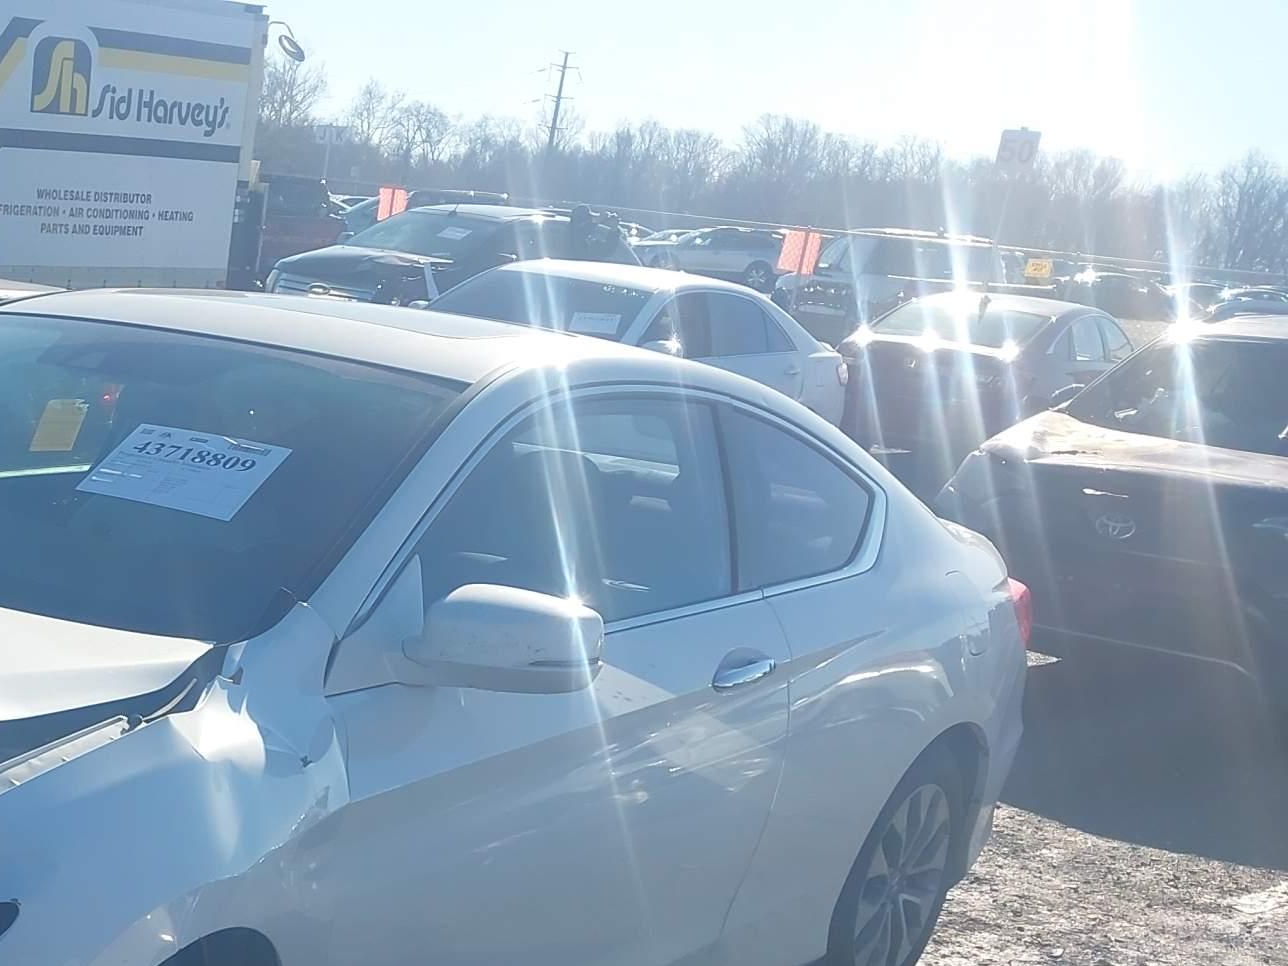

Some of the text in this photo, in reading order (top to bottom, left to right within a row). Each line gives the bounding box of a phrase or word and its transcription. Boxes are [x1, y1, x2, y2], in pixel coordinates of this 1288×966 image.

[91, 84, 230, 138] Sid Harvey's
[37, 188, 152, 205] WHOLESALE DISTRIBUTOR
[68, 207, 84, 218] AIR
[86, 207, 150, 221] CONDITIONING
[158, 210, 193, 222] HEATING
[40, 223, 144, 237] PARTS AND EQUIPMENT
[134, 441, 257, 472] 43718809
